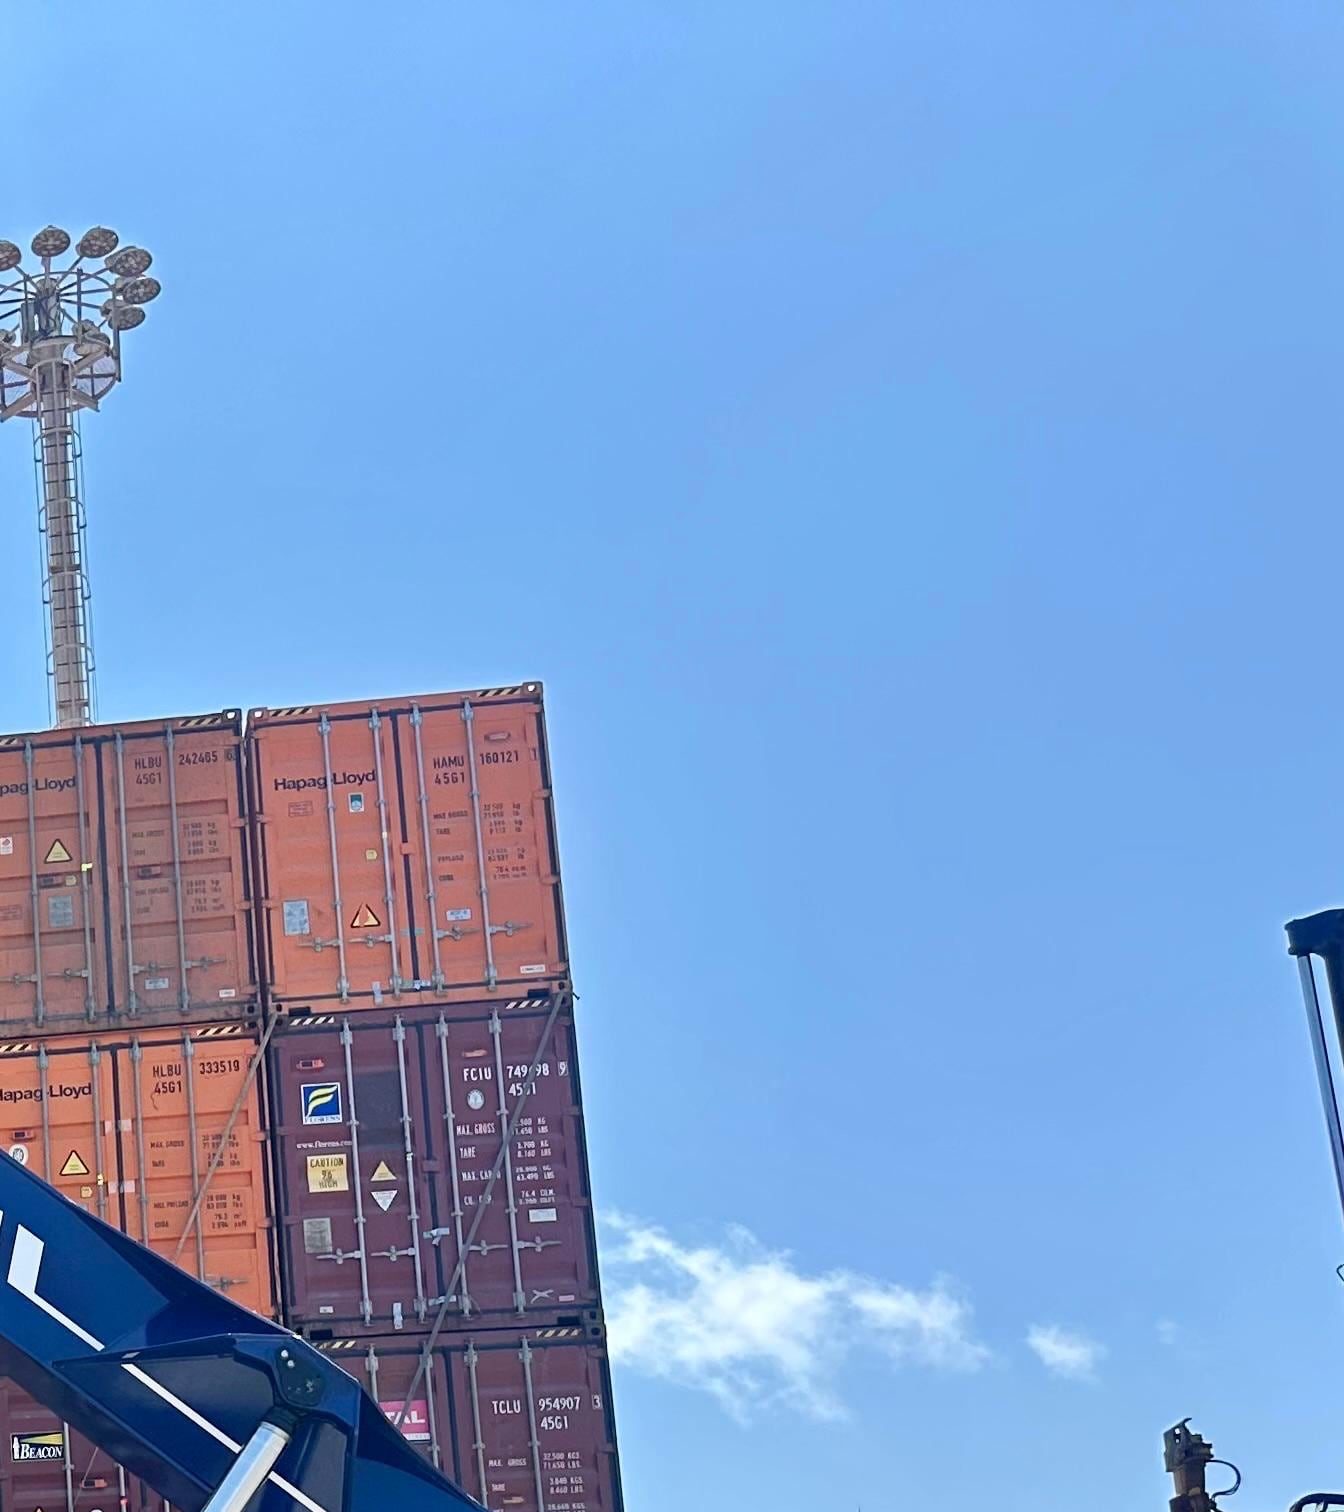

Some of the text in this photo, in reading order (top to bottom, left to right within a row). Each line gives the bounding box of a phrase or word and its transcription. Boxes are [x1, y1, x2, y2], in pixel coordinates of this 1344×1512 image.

[433, 752, 519, 769] HAMU 160121
[274, 769, 377, 791] HapagLloyd
[434, 772, 465, 784] 45G1
[153, 1064, 182, 1077] HLBU
[154, 1081, 183, 1094] 45G1
[492, 1400, 521, 1414] TCLU
[538, 1396, 581, 1411] 954907
[540, 1415, 569, 1430] 45G1
[20, 1443, 63, 1460] BEACON
